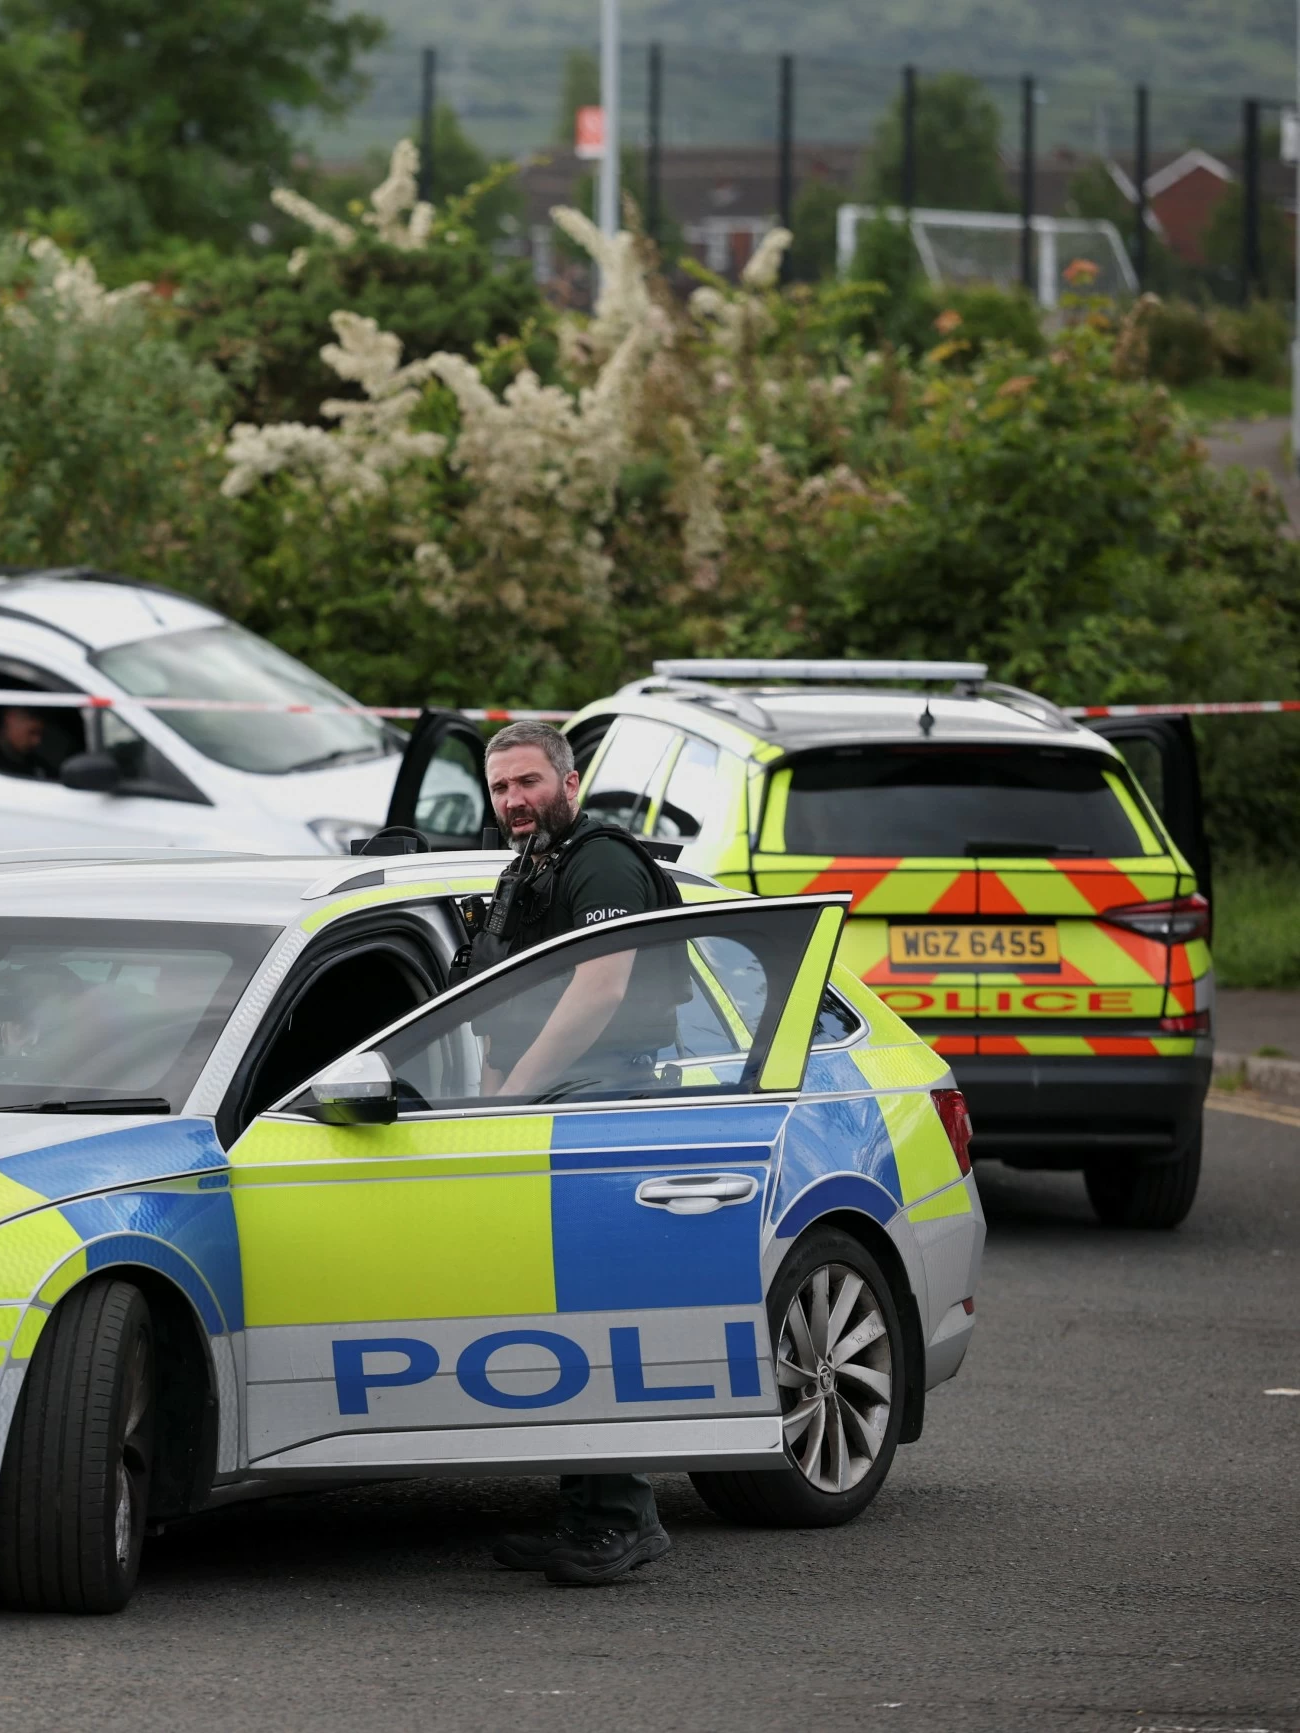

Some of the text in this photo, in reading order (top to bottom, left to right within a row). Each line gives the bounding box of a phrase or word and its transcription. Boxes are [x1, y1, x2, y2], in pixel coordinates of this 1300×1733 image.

[903, 931, 1046, 957] WGZ 6455
[878, 990, 1133, 1013] OLICE
